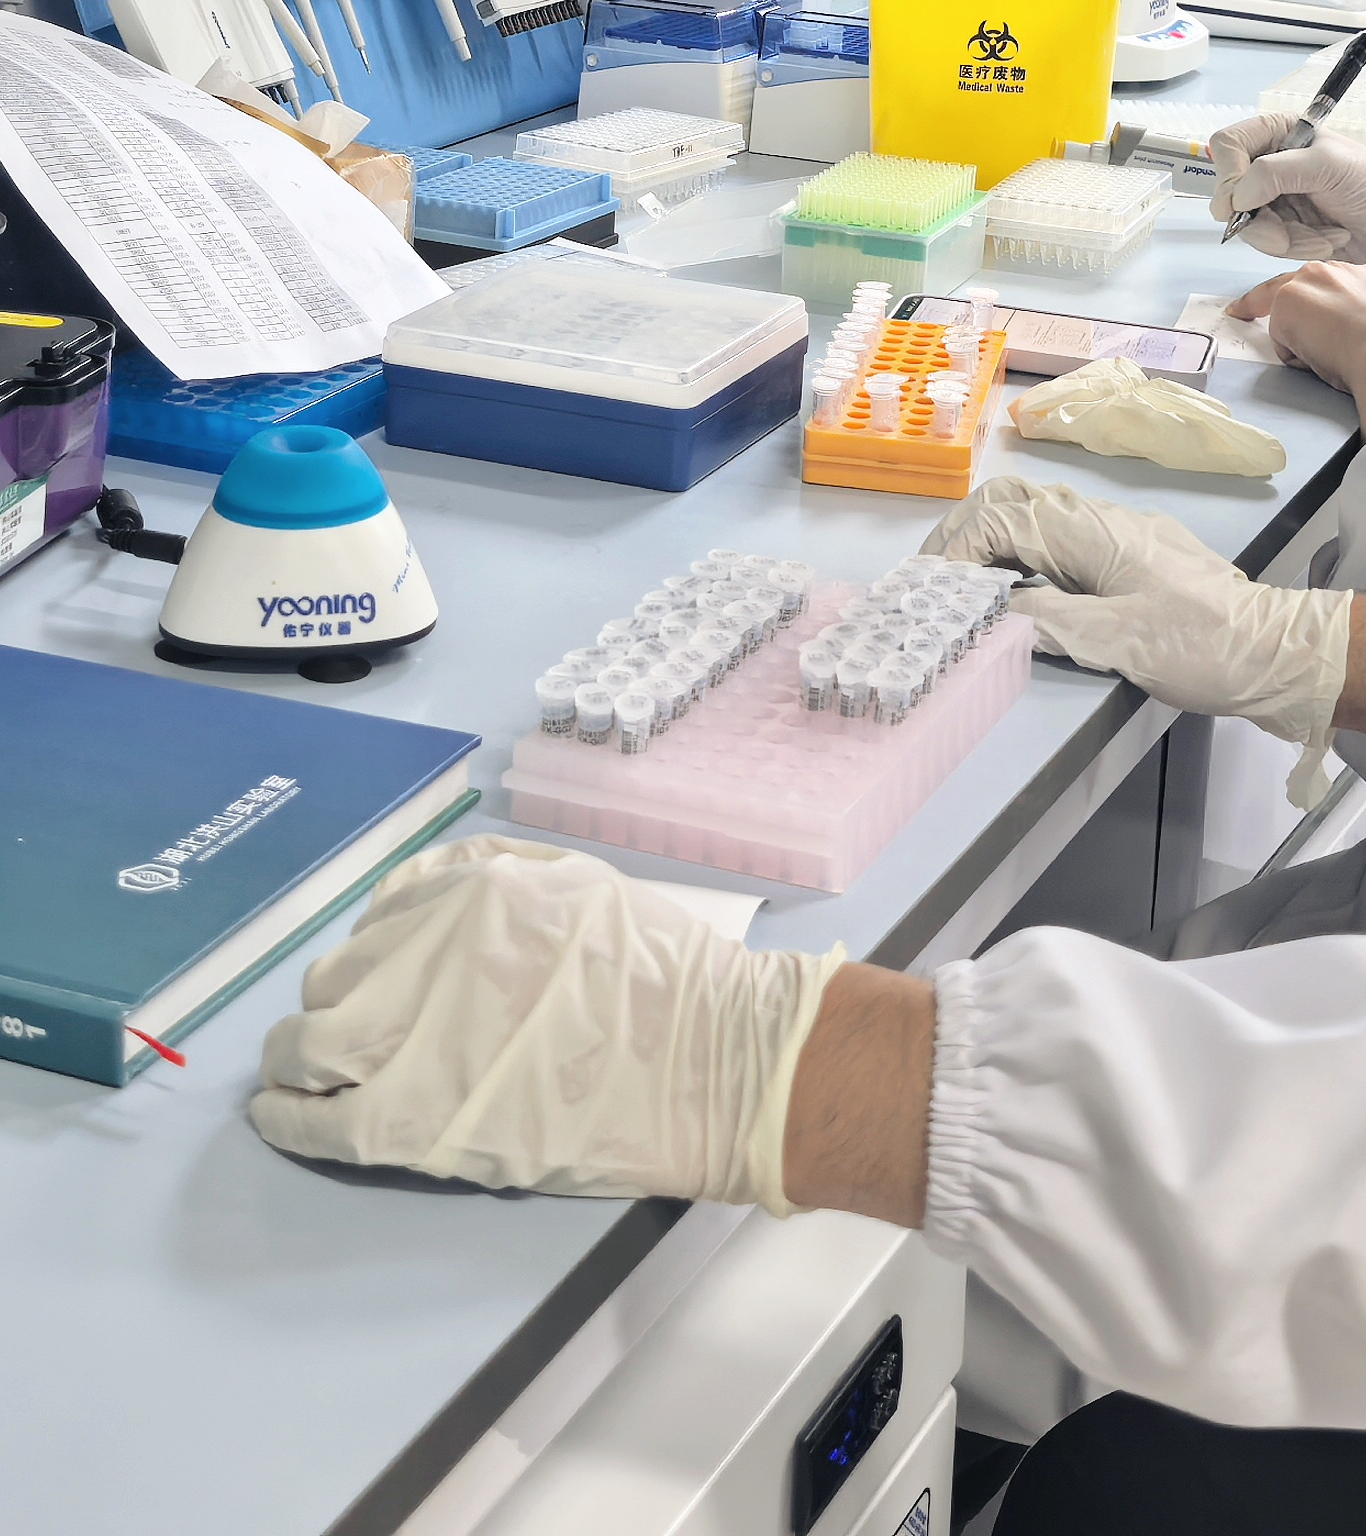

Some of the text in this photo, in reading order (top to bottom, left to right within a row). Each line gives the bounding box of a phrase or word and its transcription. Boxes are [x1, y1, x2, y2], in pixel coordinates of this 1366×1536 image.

[959, 65, 1026, 81] 医疗废物
[958, 81, 1024, 93] Medical Waste
[257, 592, 377, 627] yooning
[283, 621, 352, 638] 佑宁仪器
[152, 774, 297, 865] 湖北洪山实验室
